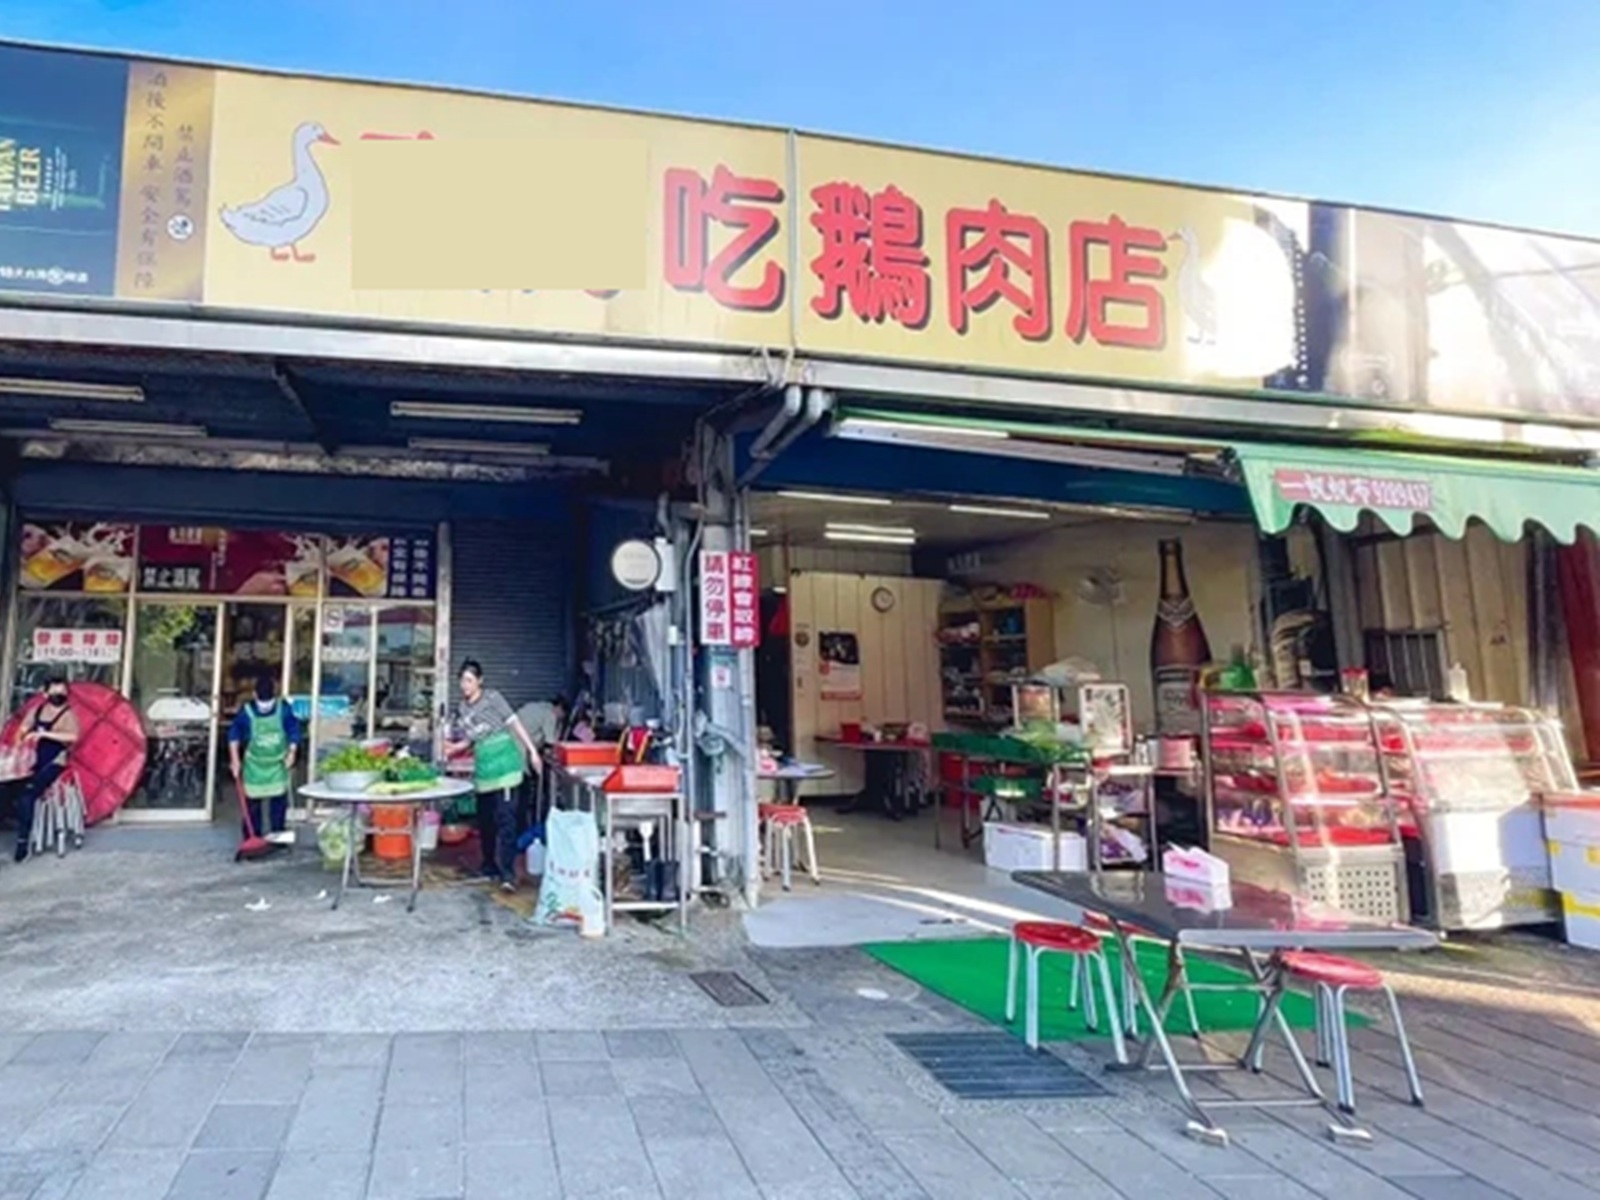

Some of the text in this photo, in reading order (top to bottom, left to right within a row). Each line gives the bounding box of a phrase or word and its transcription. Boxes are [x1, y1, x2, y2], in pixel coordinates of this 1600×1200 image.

[16, 147, 42, 206] BEER
[664, 164, 1167, 349] 吃鵝肉店
[143, 566, 201, 590] 禁止酒駕
[705, 555, 726, 640] 請勿停車
